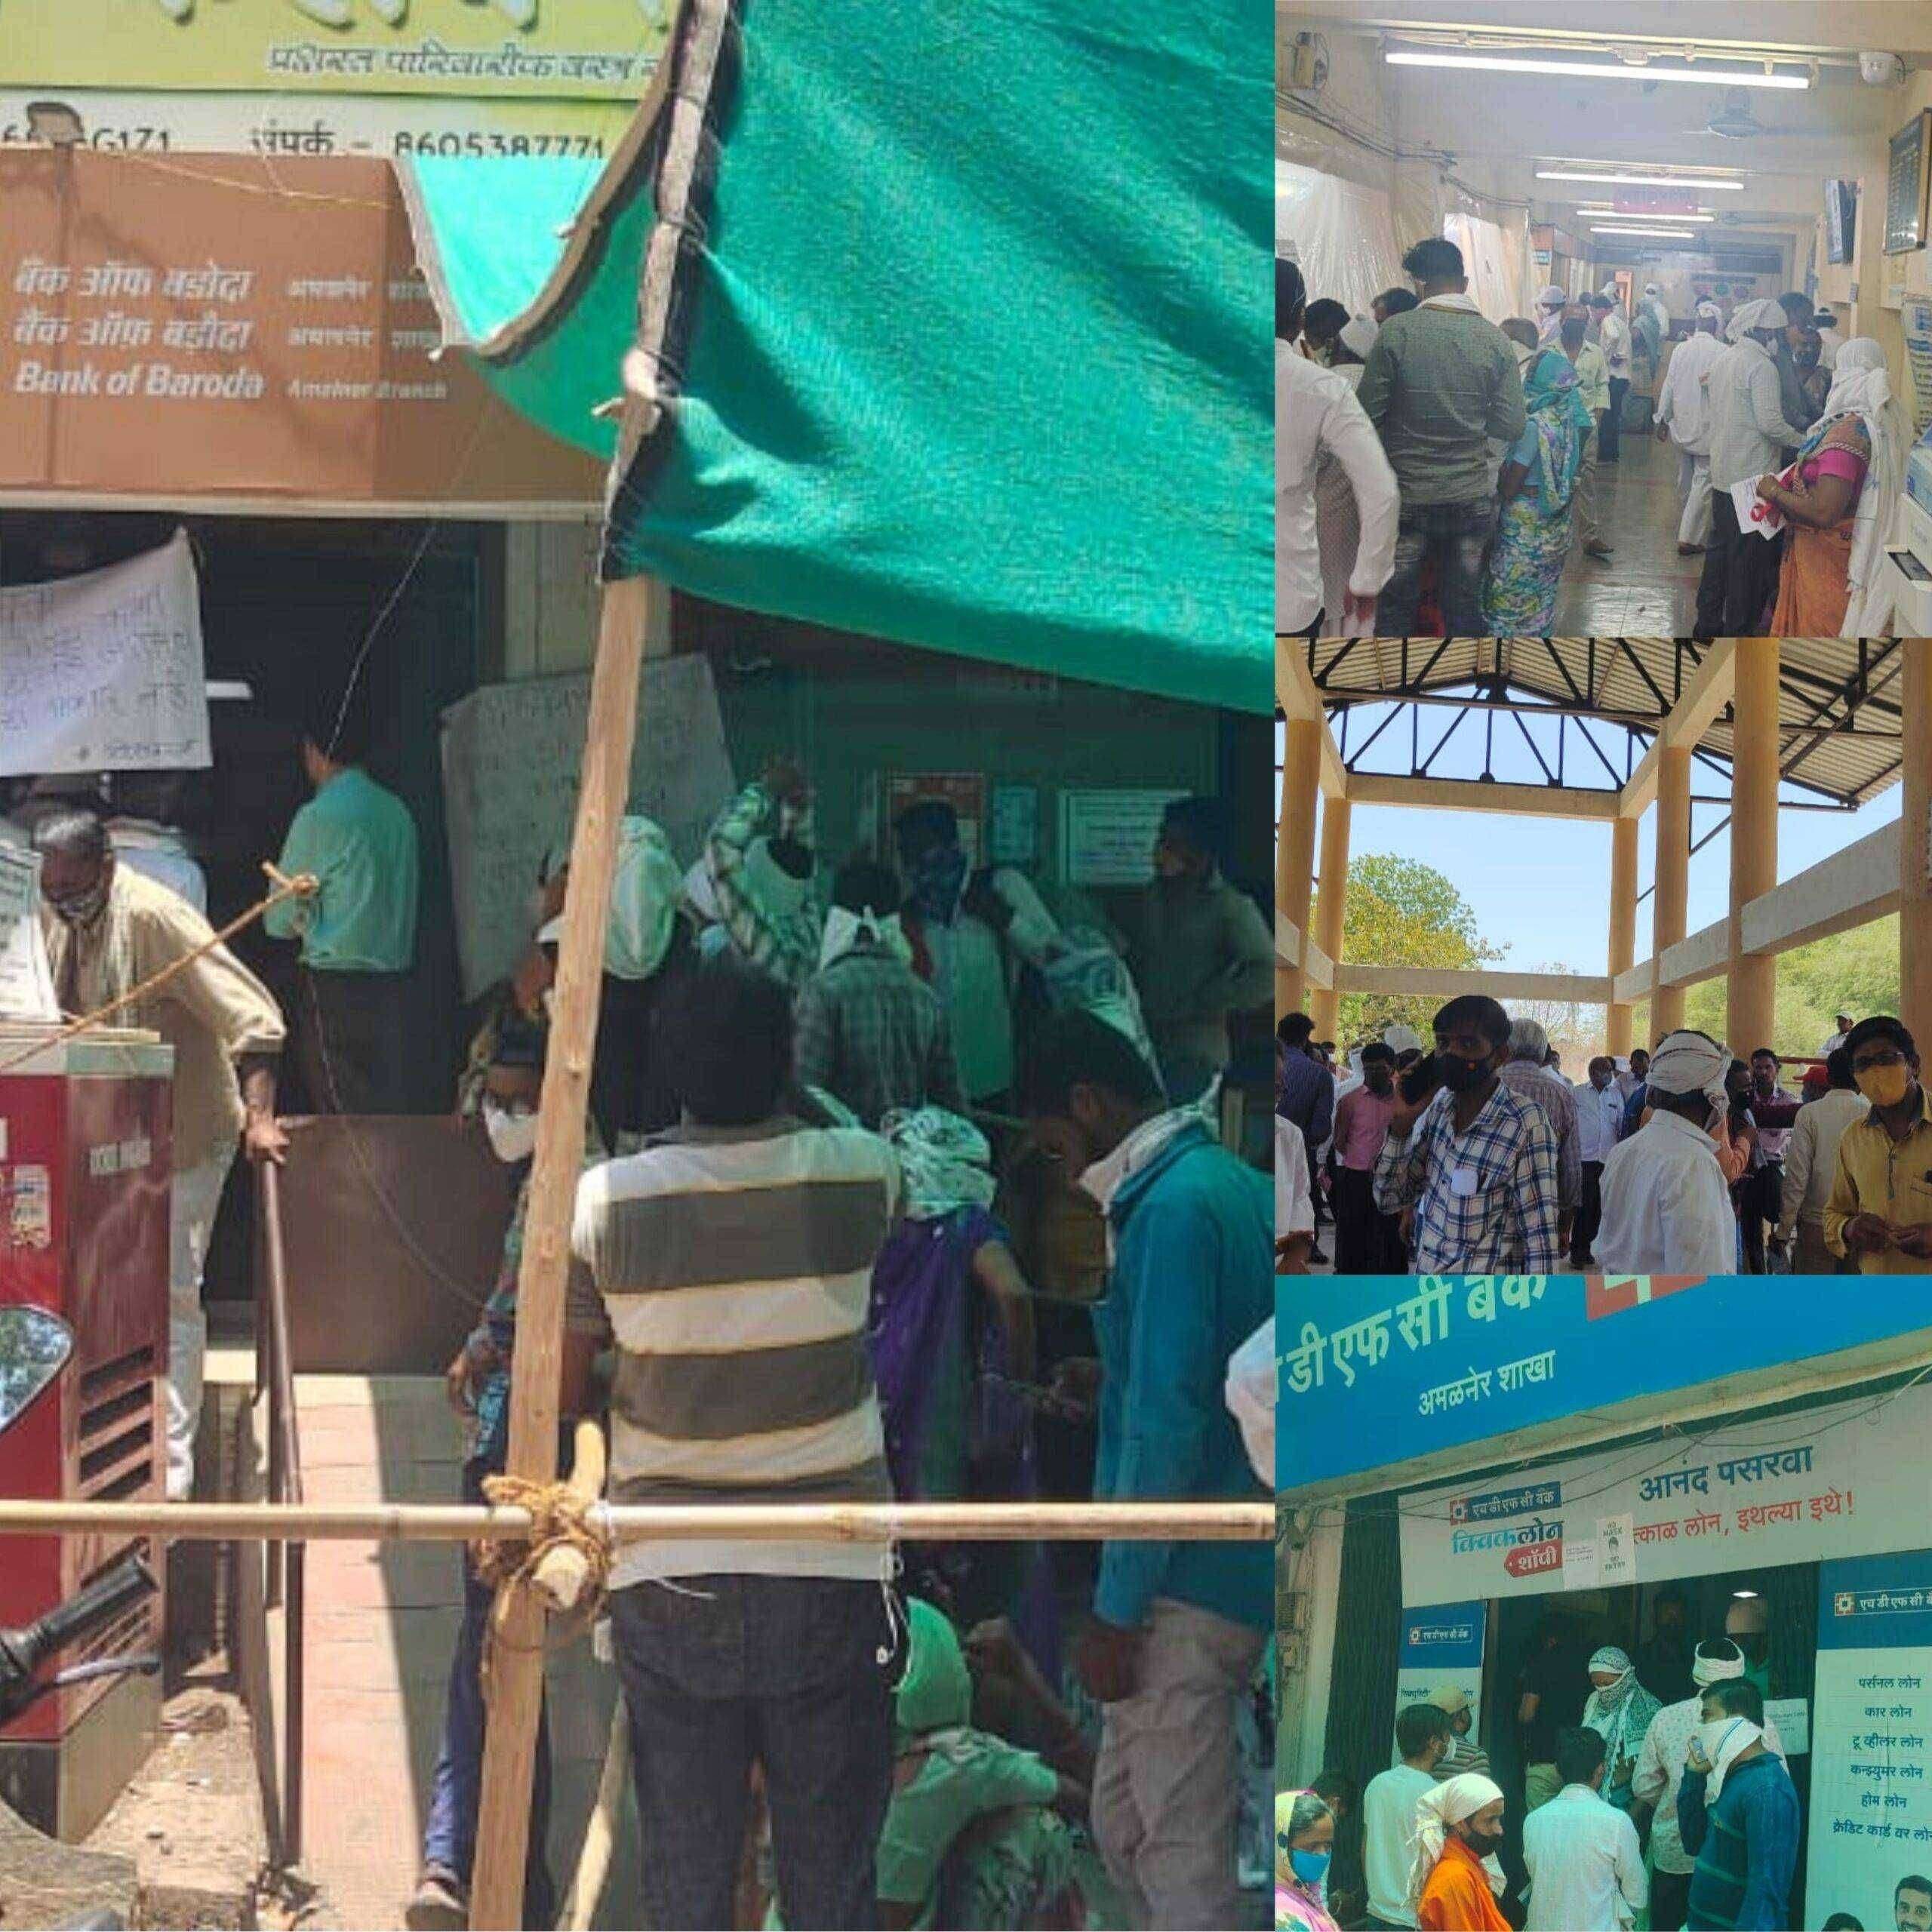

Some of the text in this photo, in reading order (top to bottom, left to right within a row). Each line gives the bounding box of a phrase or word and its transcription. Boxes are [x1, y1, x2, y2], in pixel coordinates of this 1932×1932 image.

[14, 361, 265, 398] Bank of Baroda
[1418, 1349, 1556, 1416] अमळनेर शाखा
[1639, 1445, 1814, 1501] आनंद पसरवा
[1737, 1500, 1802, 1533] इथल्या
[1859, 1675, 1921, 1689] पर्सनल लोन
[1865, 1704, 1912, 1718] कार लोन
[1852, 1733, 1924, 1750] टू व्हीलर लोन
[1900, 1764, 1924, 1779] लोन
[1861, 1792, 1907, 1807] होम लोन
[1832, 1818, 1863, 1835] क्रेडिट
[1894, 1827, 1911, 1839] वर
